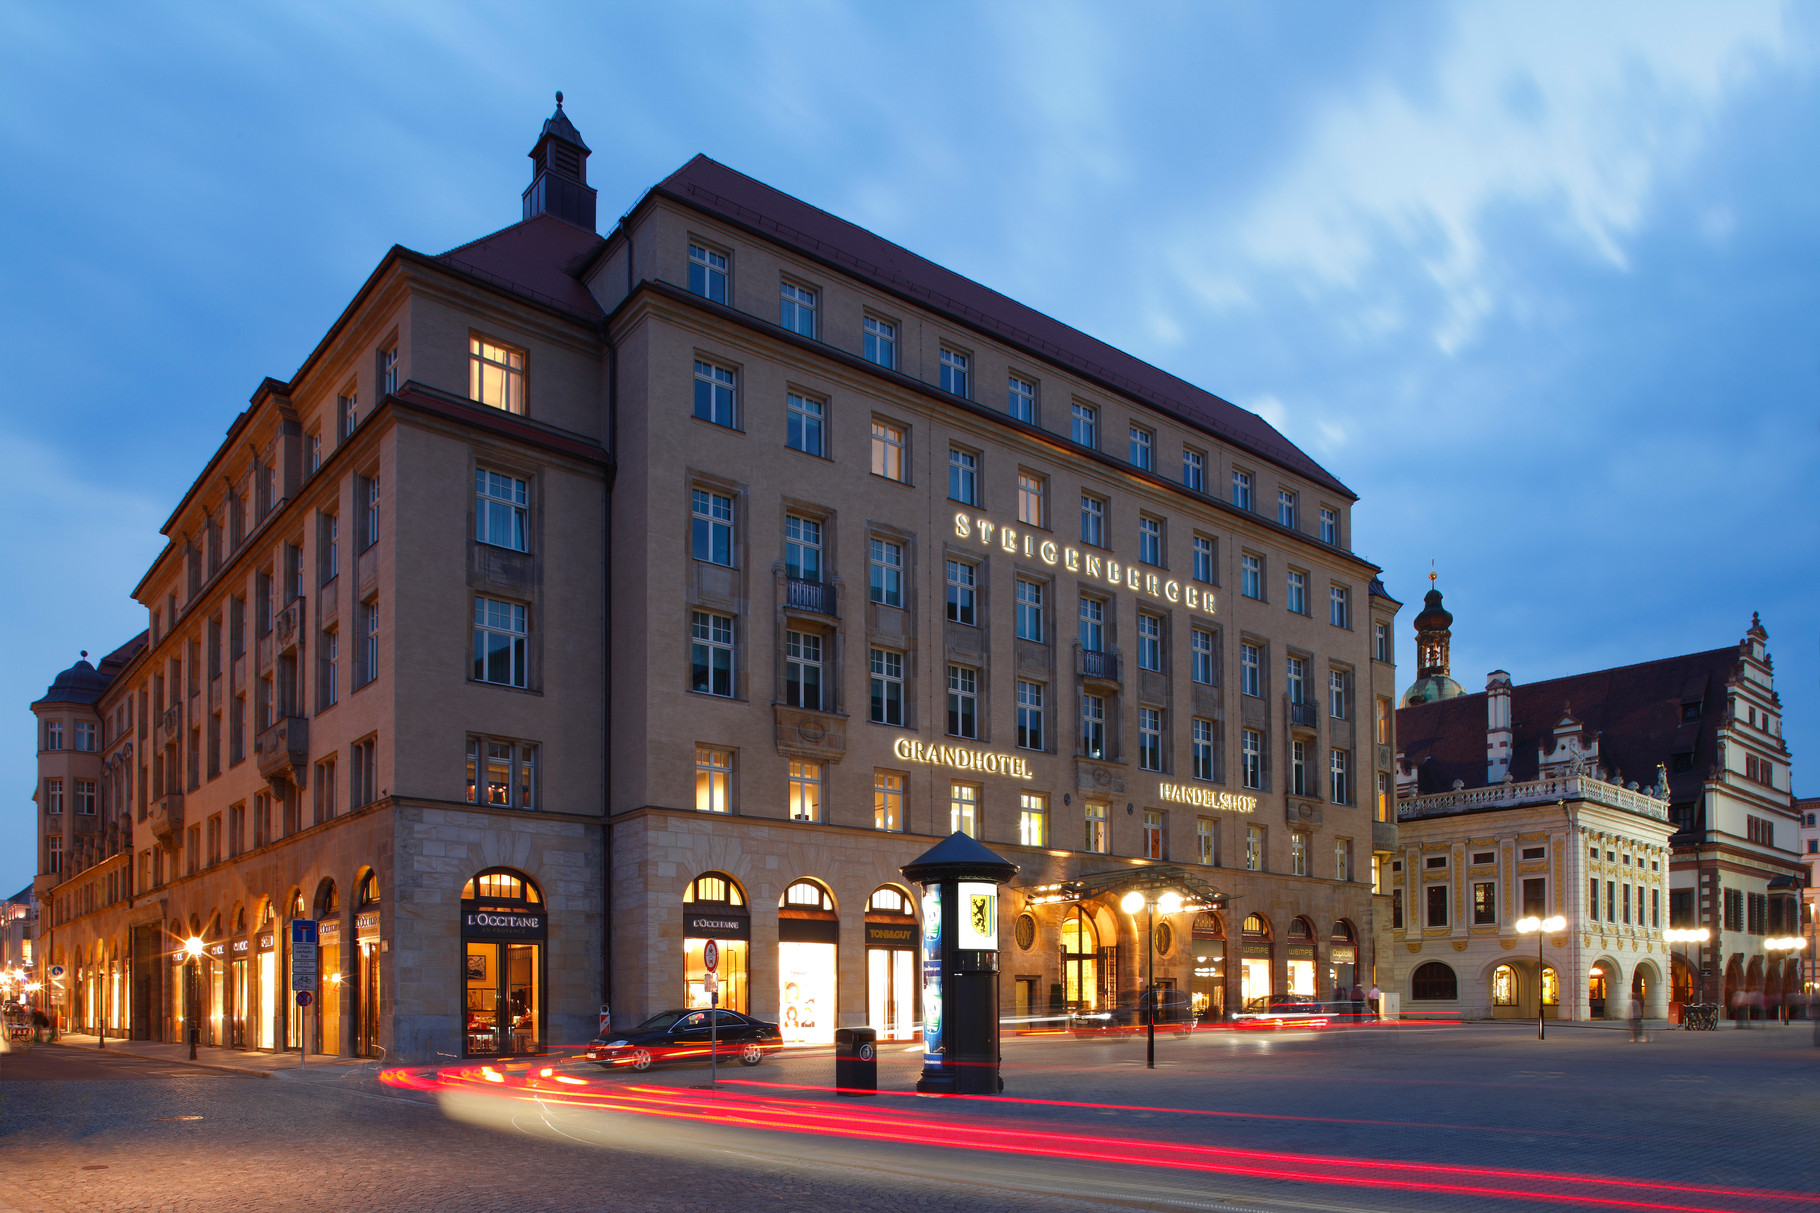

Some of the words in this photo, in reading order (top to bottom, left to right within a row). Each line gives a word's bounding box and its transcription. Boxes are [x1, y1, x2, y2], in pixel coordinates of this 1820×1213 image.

[955, 513, 1217, 613] STEIGENBERGER
[894, 738, 1033, 778] GRANDHOTEL
[1160, 783, 1257, 812] HANDELSHOF
[468, 913, 539, 928] L'OCCITANE
[693, 919, 739, 929] L'OCCITANE
[870, 929, 912, 940] TONI&GUY
[1243, 946, 1269, 955] WEMPE
[1288, 948, 1313, 956] WEMPE
